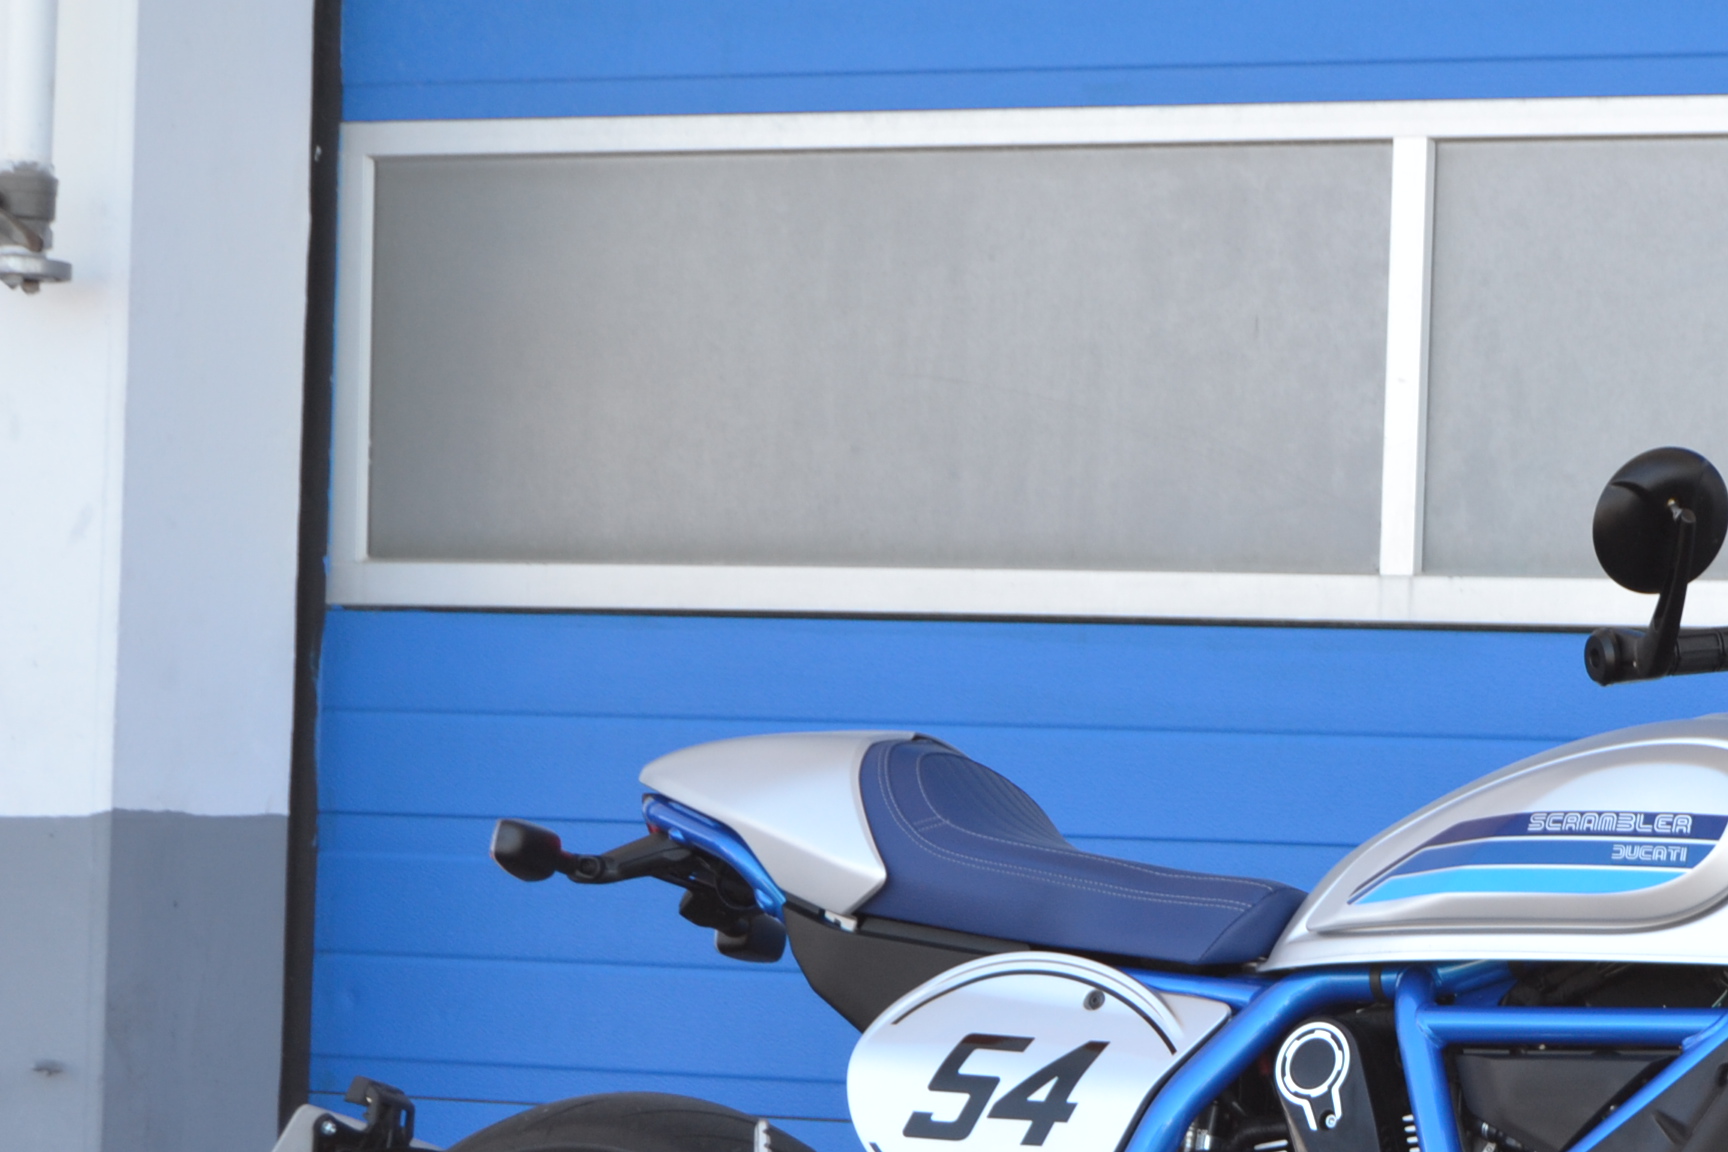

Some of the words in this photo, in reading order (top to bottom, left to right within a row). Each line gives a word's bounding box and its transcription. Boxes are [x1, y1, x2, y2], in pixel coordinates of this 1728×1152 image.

[1527, 812, 1692, 834] SCRAMBLER
[1611, 844, 1687, 862] DUCATI
[902, 1032, 1111, 1147] 54
